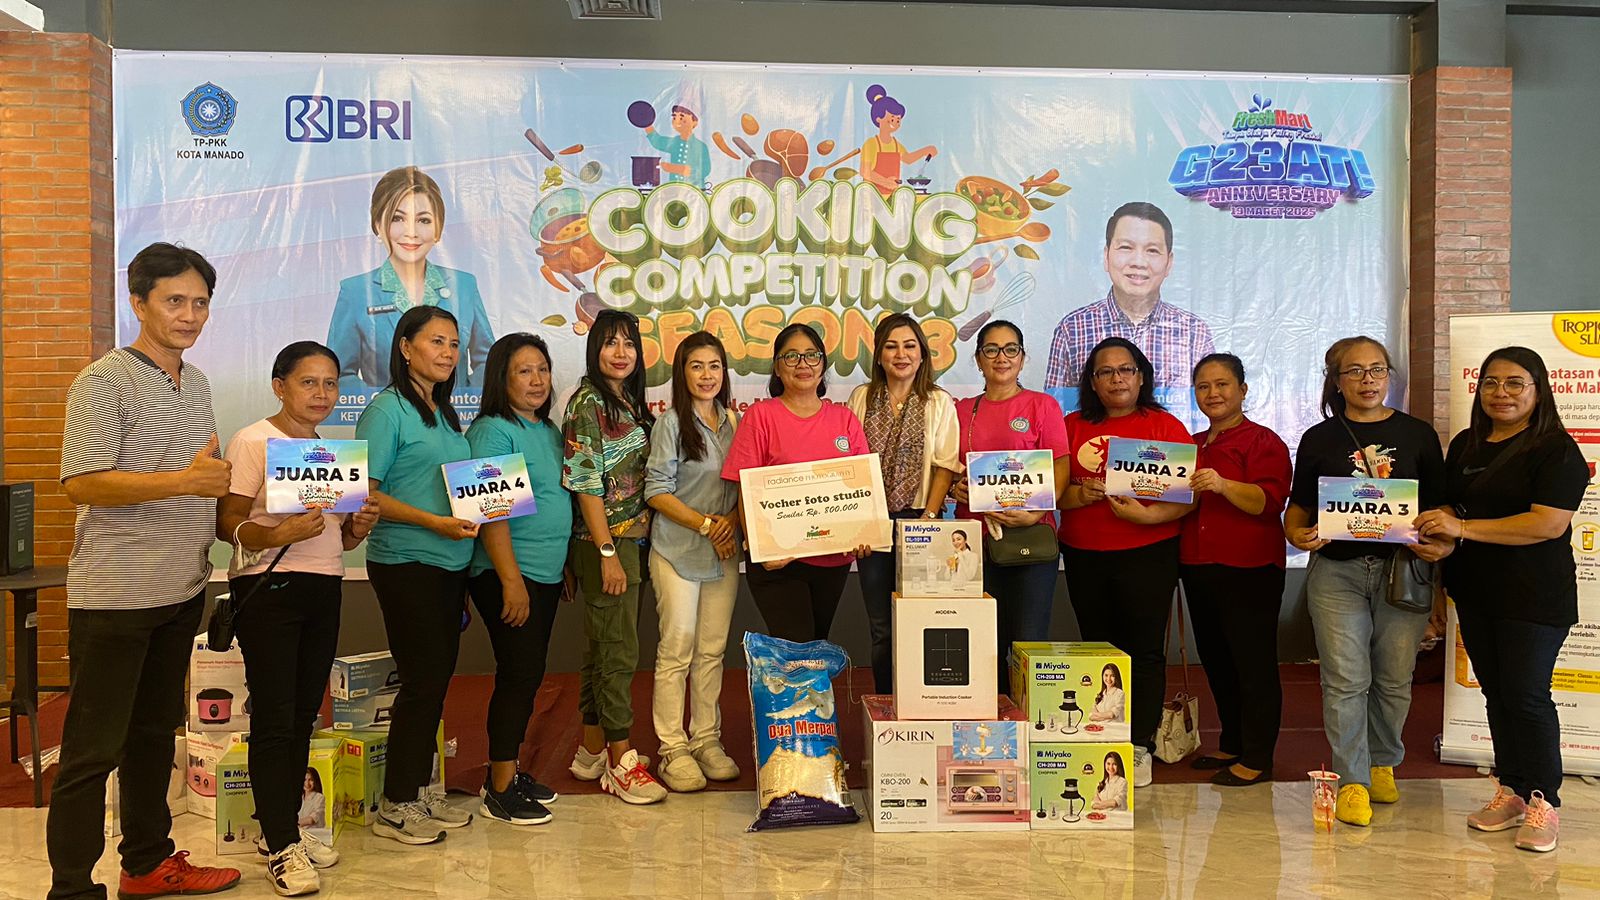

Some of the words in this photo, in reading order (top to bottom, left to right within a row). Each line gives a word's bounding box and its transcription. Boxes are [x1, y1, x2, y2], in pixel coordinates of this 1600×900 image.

[338, 100, 411, 140] BRI
[1232, 109, 1312, 129] FreshMart
[193, 138, 227, 147] TP-PKK
[177, 150, 202, 159] KOTA
[204, 150, 244, 160] MANADO
[1206, 185, 1340, 203] ANNIVERSARY
[588, 178, 978, 255] COOKING
[1246, 207, 1285, 217] MARET
[1286, 207, 1316, 217] 2025
[596, 256, 971, 311] COMPETITION
[1547, 368, 1594, 380] atasan
[1577, 382, 1600, 394] Mak
[275, 467, 344, 481] JUARA
[349, 468, 360, 481] 5
[1113, 460, 1171, 476] JUARA
[1176, 466, 1187, 477] 2
[768, 475, 803, 485] radiance
[977, 474, 1033, 486] JUARA
[1037, 473, 1044, 484] 1
[456, 479, 511, 499] JUARA
[514, 477, 525, 489] 4
[760, 498, 801, 510] Vocher
[804, 495, 829, 505] foto
[833, 489, 871, 502] studio
[1326, 501, 1392, 515] JUARA
[1398, 504, 1409, 515] 3
[912, 525, 941, 534] Miyako
[1043, 663, 1070, 671] Miyako
[768, 724, 792, 740] Dua
[795, 720, 836, 737] Merpat
[896, 730, 934, 742] KIRIN
[1044, 751, 1072, 759] Miyako
[880, 811, 892, 820] 20
